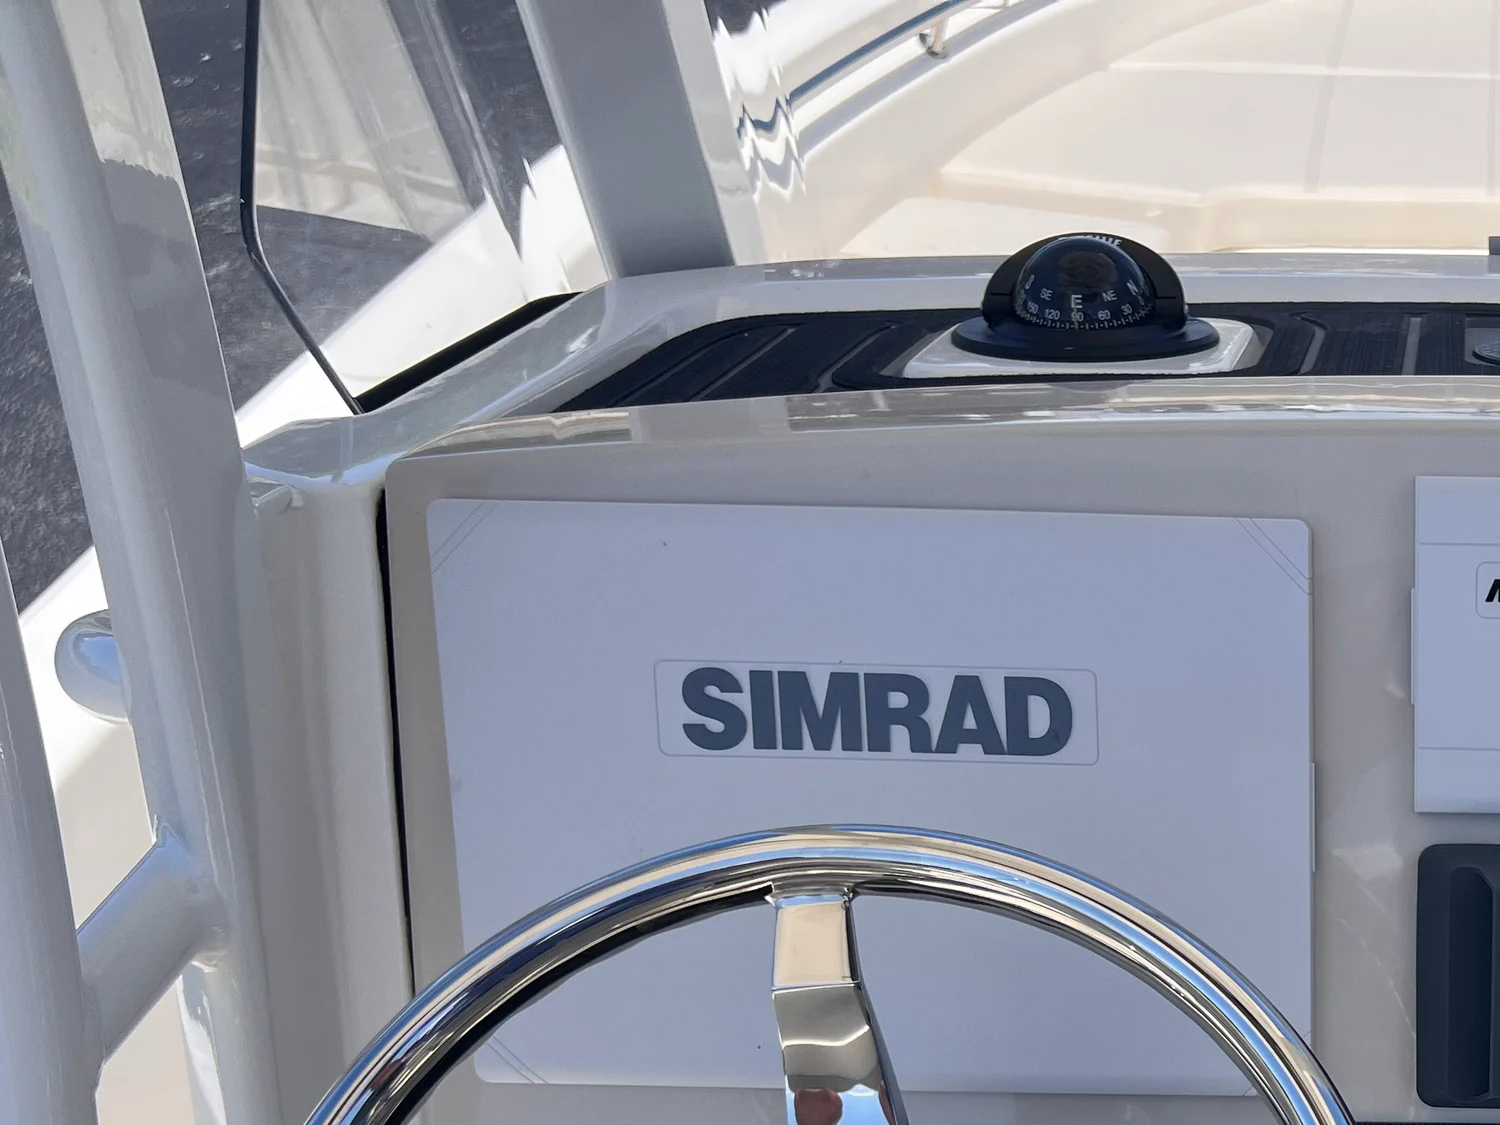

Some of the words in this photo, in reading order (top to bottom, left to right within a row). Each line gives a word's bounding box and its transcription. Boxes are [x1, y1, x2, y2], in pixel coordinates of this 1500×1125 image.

[1040, 288, 1053, 301] SE
[1102, 290, 1118, 302] NE
[1071, 294, 1083, 309] E
[1044, 309, 1060, 320] 120
[1098, 310, 1111, 320] 60
[1121, 304, 1133, 315] 30
[681, 667, 1073, 756] SIMRAD
